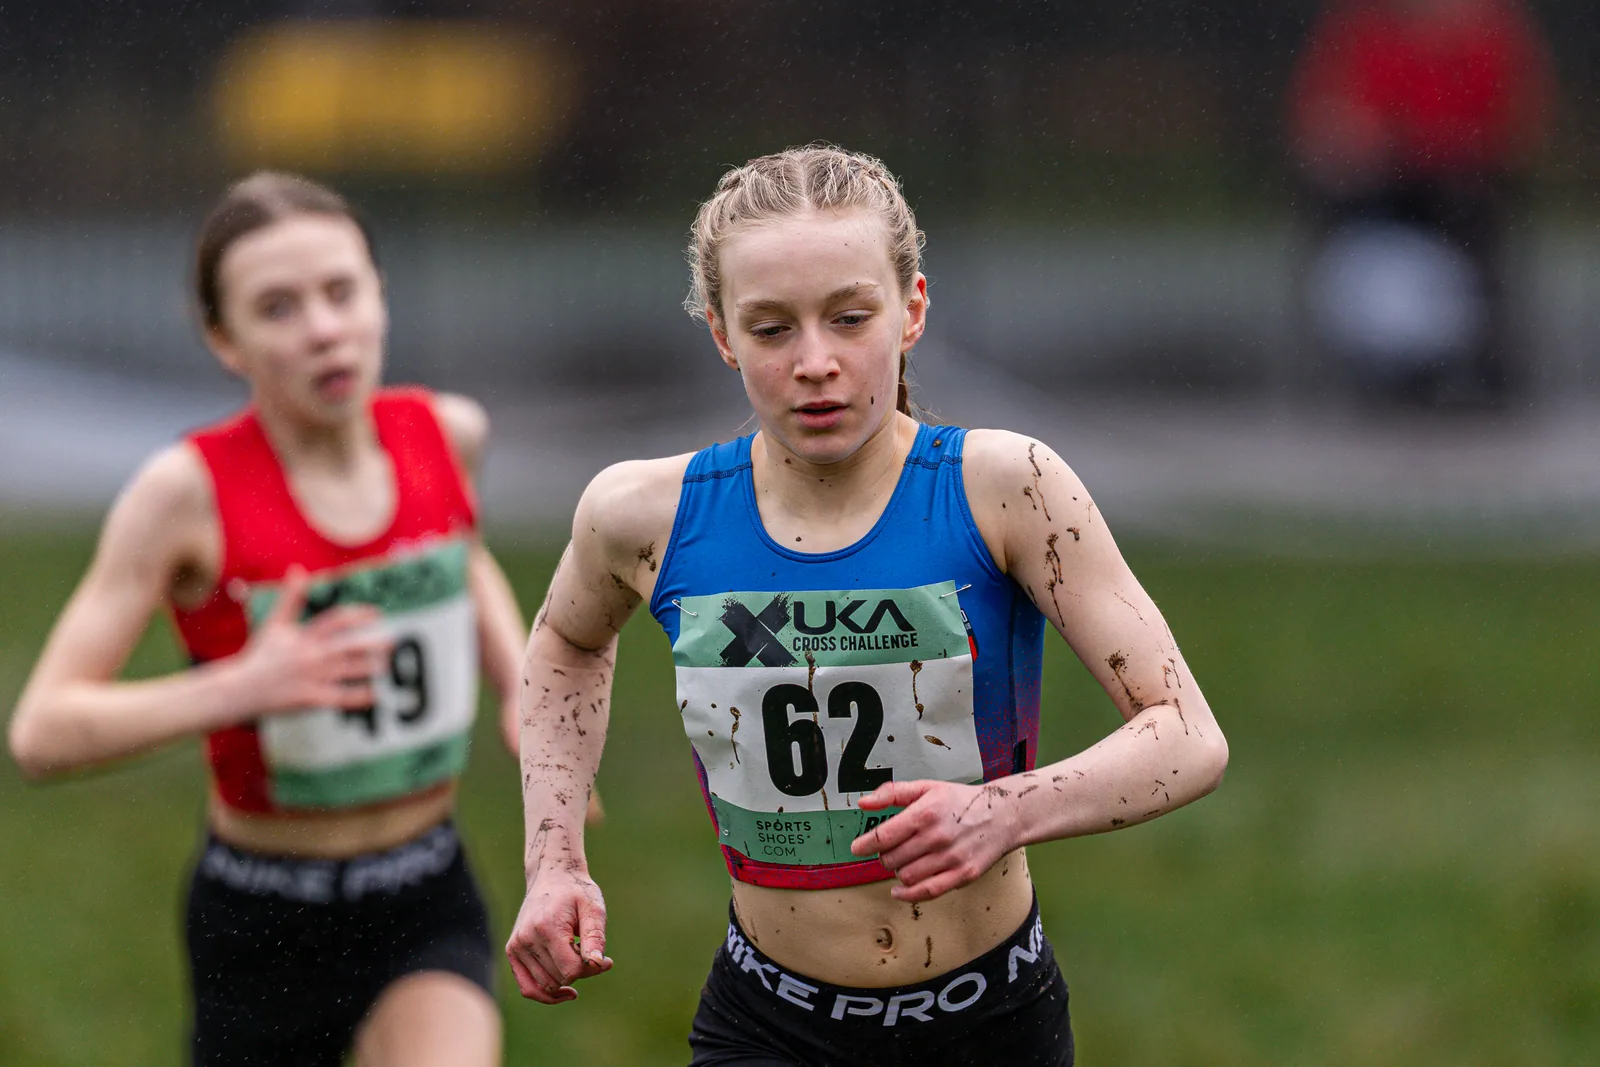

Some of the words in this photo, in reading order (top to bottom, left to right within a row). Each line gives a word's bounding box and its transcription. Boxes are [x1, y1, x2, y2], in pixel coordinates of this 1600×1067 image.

[793, 599, 916, 635] UKA
[792, 635, 837, 652] CROSS
[840, 632, 919, 651] CHALLENGE
[761, 681, 894, 796] 62
[756, 820, 812, 832] SPORTS
[758, 833, 805, 845] SHOES
[829, 971, 988, 1027] PRO
